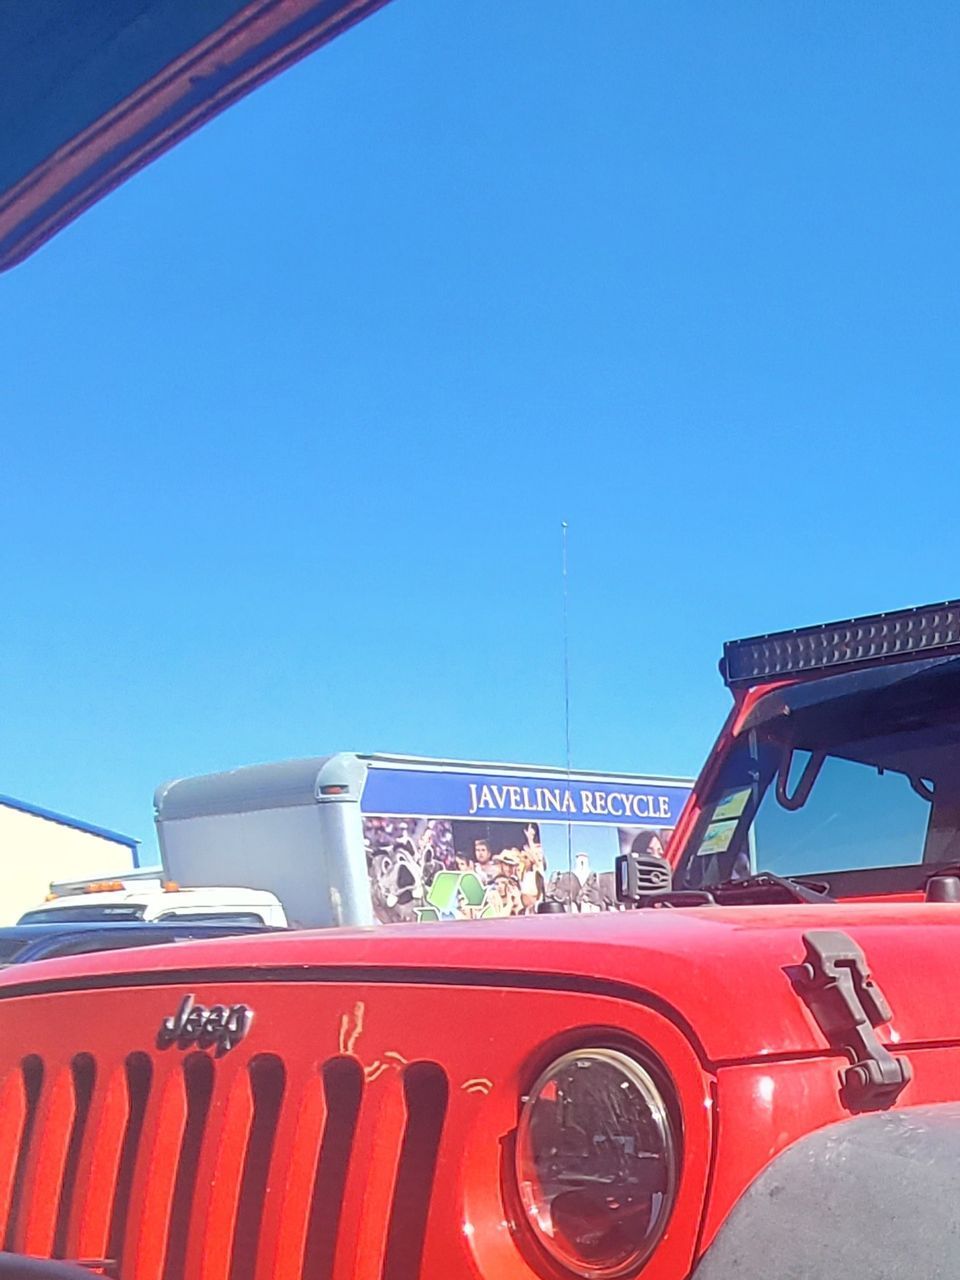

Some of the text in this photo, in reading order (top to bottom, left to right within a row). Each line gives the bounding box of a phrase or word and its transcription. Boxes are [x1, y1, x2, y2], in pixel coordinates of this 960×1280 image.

[468, 783, 672, 818] JAVELINA RECYCLE
[155, 993, 255, 1059] Jeep
